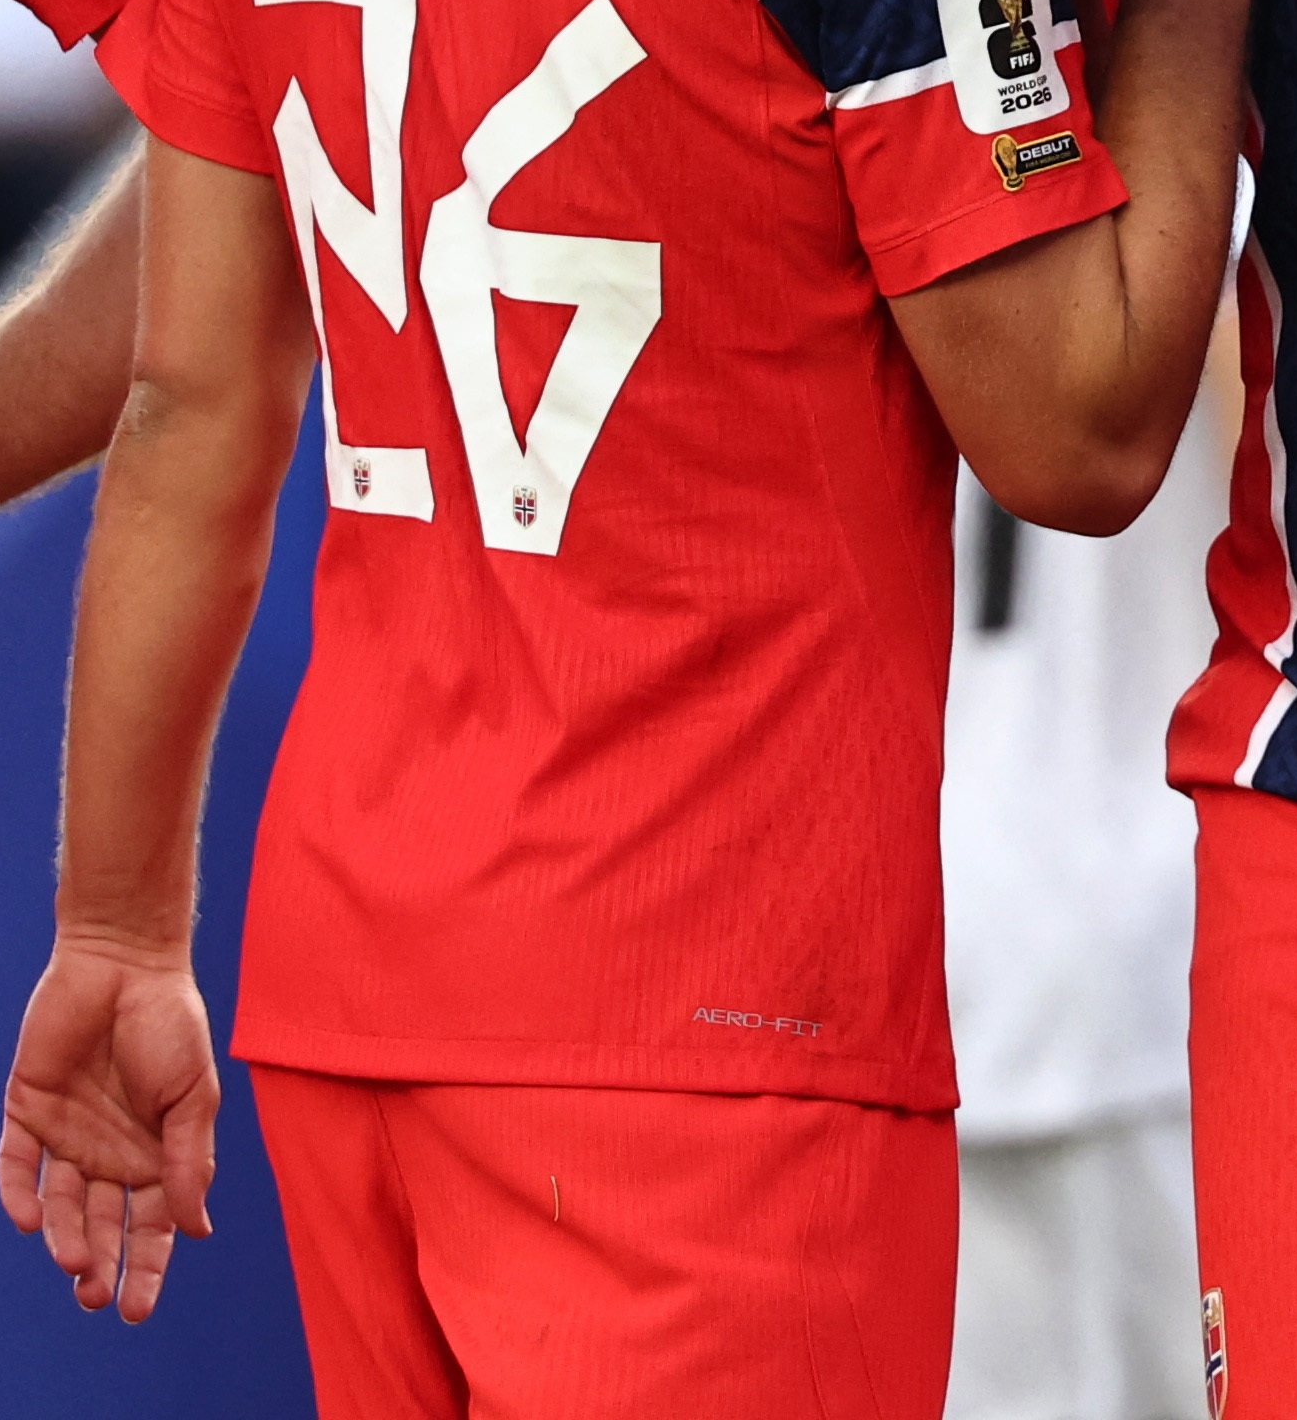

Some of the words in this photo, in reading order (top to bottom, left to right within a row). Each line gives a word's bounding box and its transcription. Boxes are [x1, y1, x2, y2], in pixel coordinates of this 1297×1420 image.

[1009, 52, 1036, 70] FIFA
[997, 79, 1037, 97] WORLD
[1000, 86, 1053, 114] 2026
[1019, 137, 1071, 162] DEBUT
[693, 1007, 823, 1038] AERO-FIT
